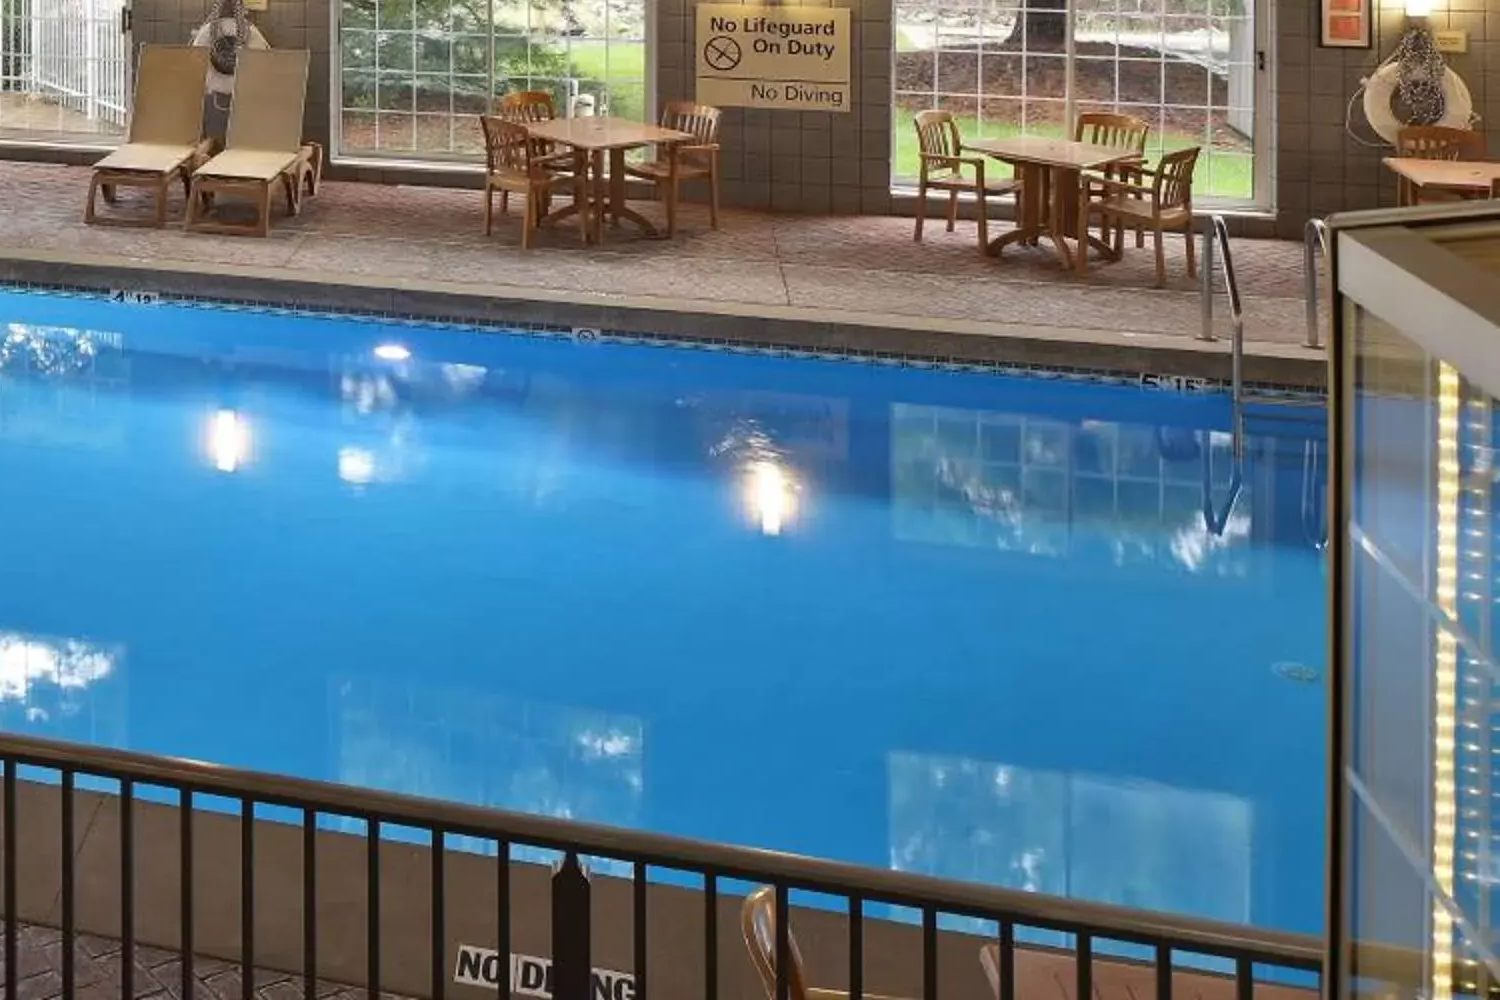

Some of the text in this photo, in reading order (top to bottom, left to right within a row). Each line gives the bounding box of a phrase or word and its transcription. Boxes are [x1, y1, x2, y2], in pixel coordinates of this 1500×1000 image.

[710, 16, 835, 38] No Lifeguard
[753, 38, 835, 60] On Duty
[751, 84, 843, 107] No Diving
